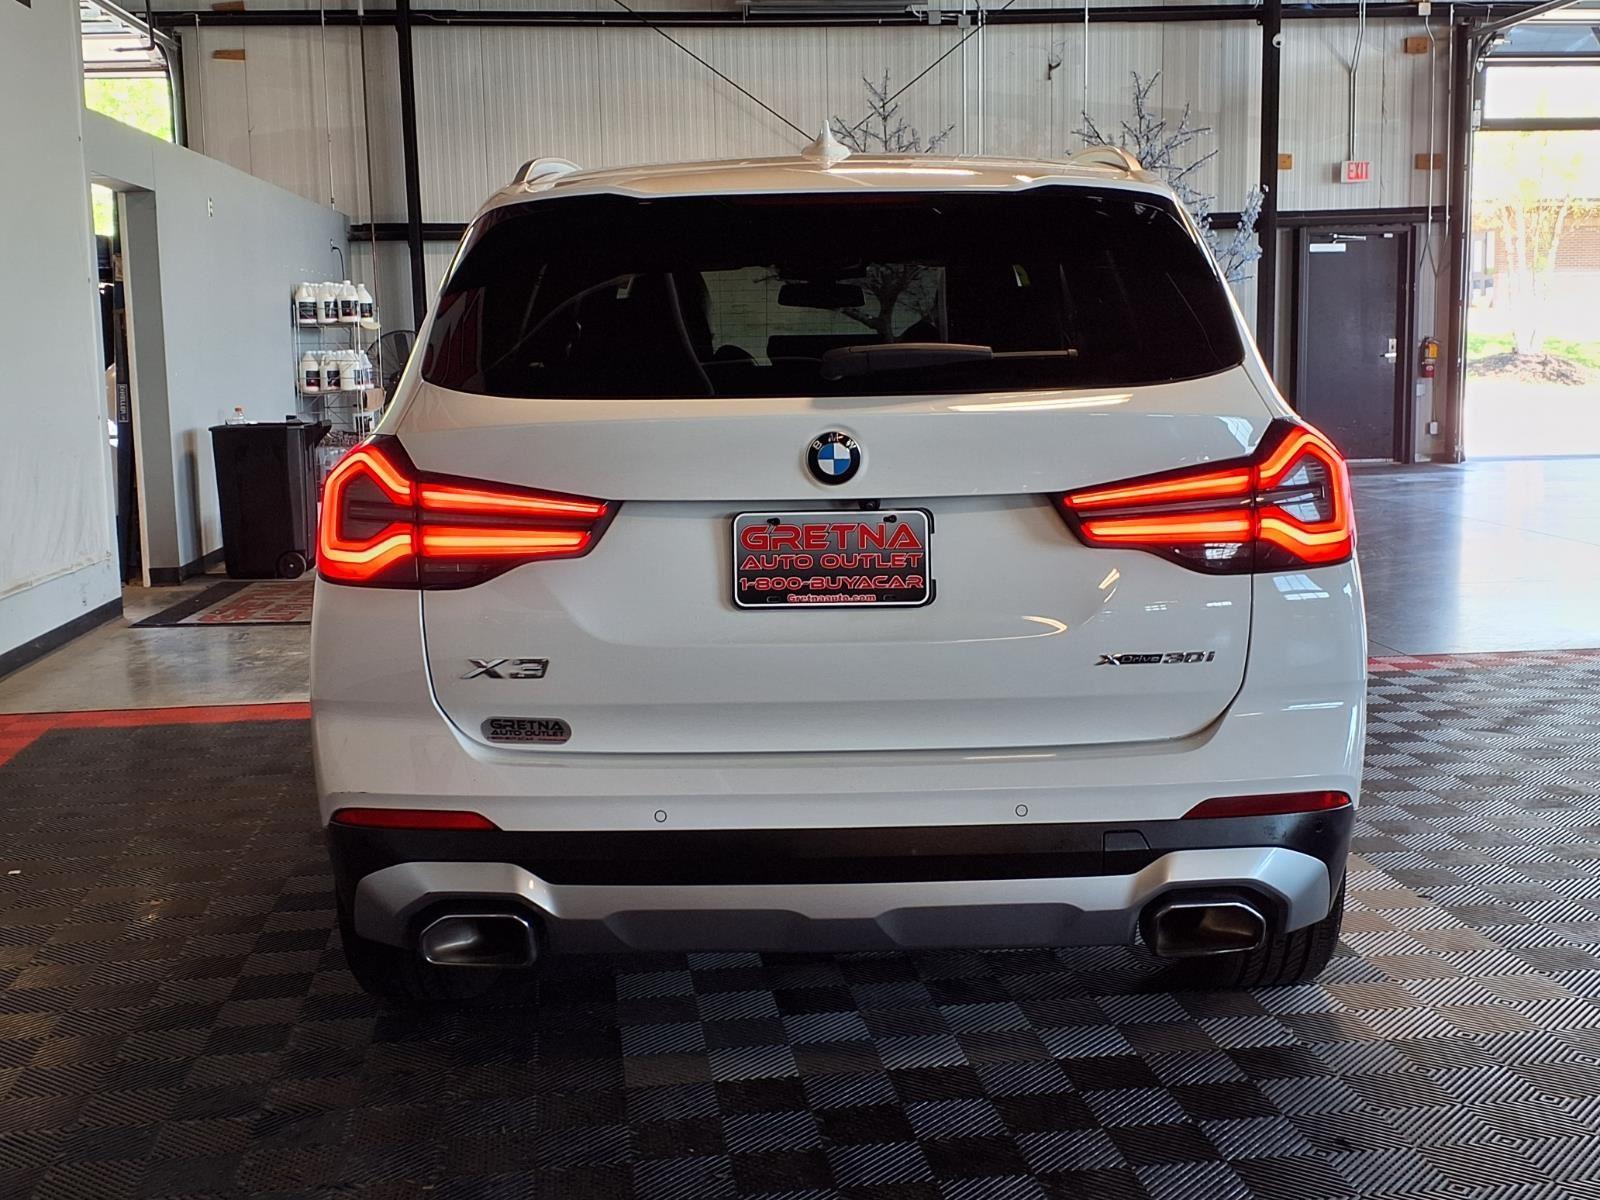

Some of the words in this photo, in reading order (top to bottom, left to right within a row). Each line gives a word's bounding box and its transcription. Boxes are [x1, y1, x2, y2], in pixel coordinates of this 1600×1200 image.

[1347, 161, 1370, 180] EXIT
[811, 432, 858, 450] BMW
[740, 522, 922, 551] GRETNA
[739, 554, 814, 571] AUTO
[820, 552, 924, 570] OUTLET
[739, 575, 925, 591] 1-800-BUYACAR
[786, 593, 877, 603] Gretnaauto.com
[460, 658, 549, 680] X3
[490, 719, 564, 730] GRETNA
